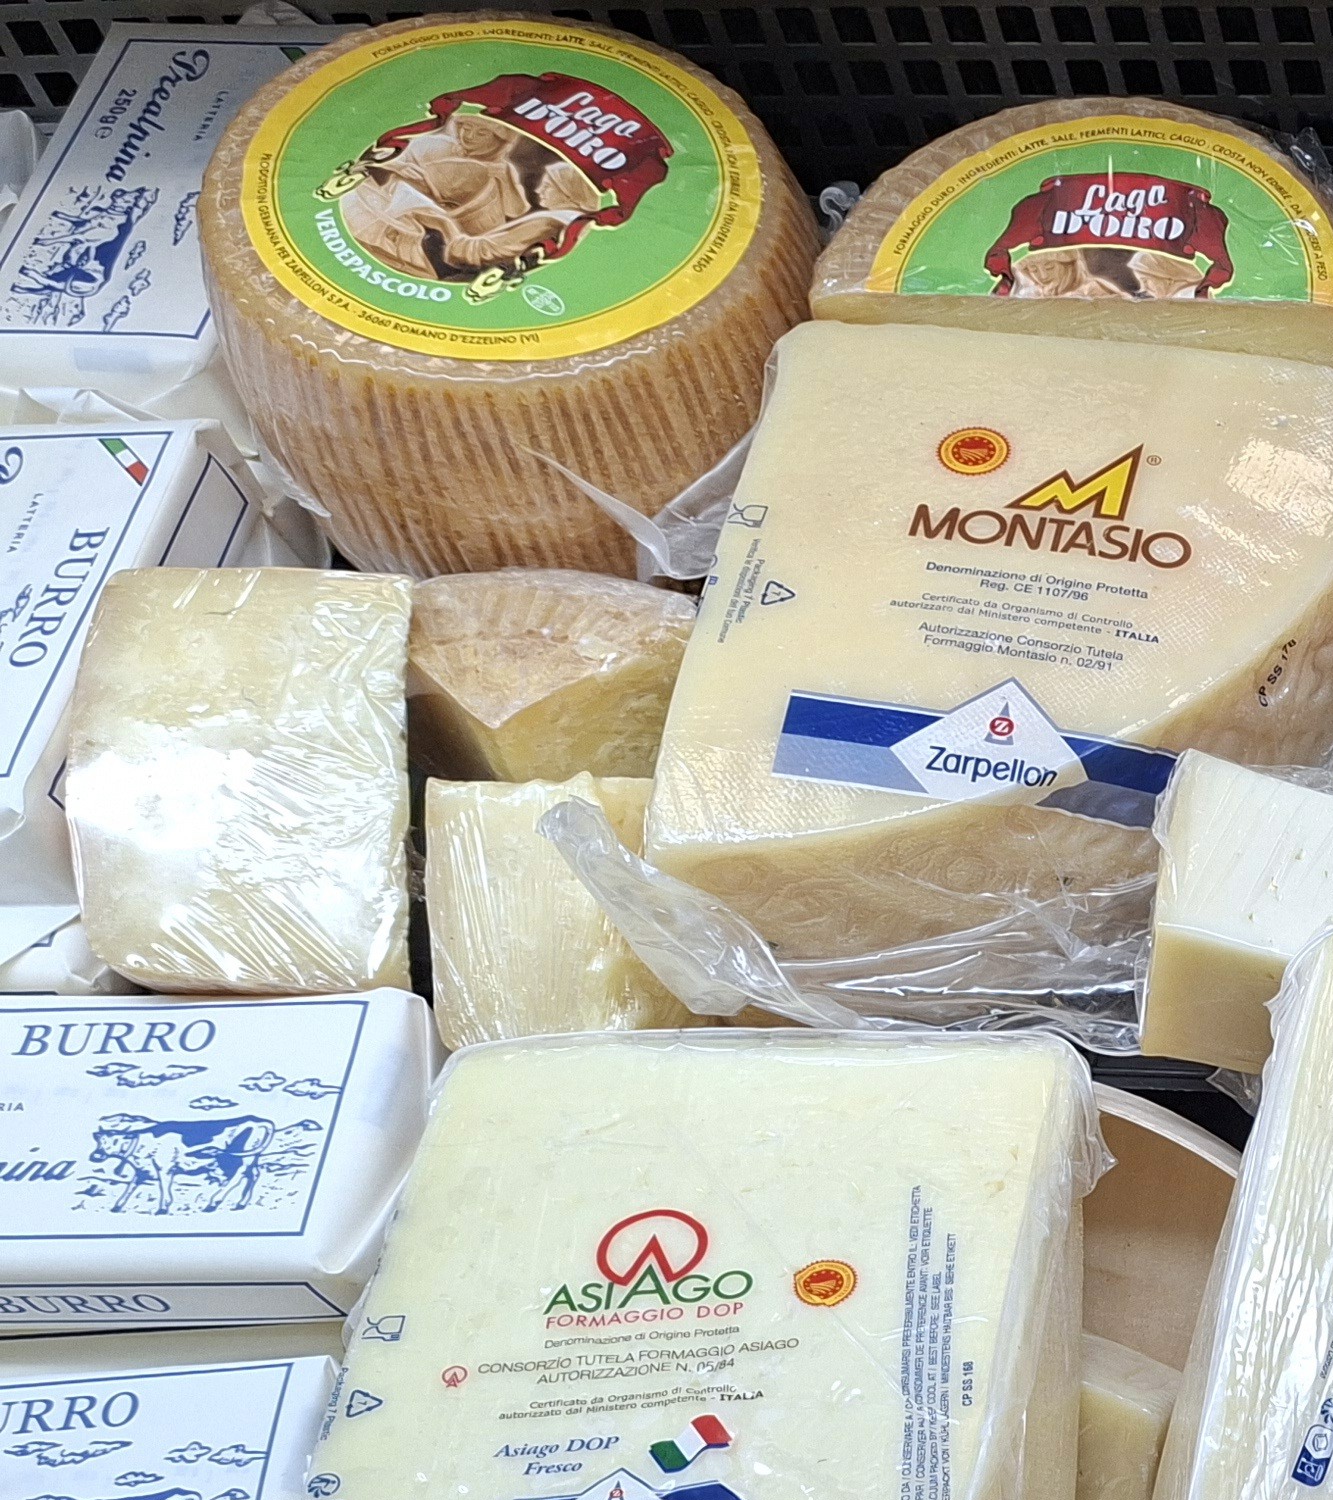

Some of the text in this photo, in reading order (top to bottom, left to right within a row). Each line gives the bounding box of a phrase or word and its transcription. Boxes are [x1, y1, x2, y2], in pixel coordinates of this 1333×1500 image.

[548, 91, 639, 139] Lago
[1079, 126, 1129, 140] FERMENTI
[1075, 184, 1168, 217] Lago
[314, 208, 452, 302] VERDEPASCOLO
[393, 322, 447, 342] ROMANO
[908, 503, 1192, 569] MONTASIO
[9, 526, 110, 668] BURRO
[925, 561, 1149, 599] Denominazione Origine Protetta
[980, 578, 1089, 601] Reg. CE 1107/96
[921, 592, 1133, 629] Certificato Organismo Controllo
[978, 608, 1160, 644] Ministero competente ITALIA
[918, 621, 1124, 661] Autorizzazione Consorzio Tutela
[923, 634, 1113, 672] Formaggio Montasio 02/91
[1267, 664, 1283, 685] SS
[925, 745, 1058, 787] Zarpellon
[11, 1019, 216, 1056] BURRO
[0, 1293, 171, 1315] BURRO
[543, 1263, 754, 1315] ASIAGO
[546, 1302, 745, 1329] FORMAGGIO DOP
[544, 1325, 740, 1349] Denominazione Origine Protetta
[477, 1338, 800, 1375] CONSORZIO TUTELA FORMAGGIO ASIAGO
[536, 1362, 671, 1384] AUTORIZZAZIONE
[675, 1362, 692, 1373] N.
[0, 1391, 139, 1435] RRO
[529, 1390, 668, 1411] Certificato Organismo
[586, 1401, 638, 1414] Ministero
[492, 1436, 620, 1459] Asiago DOP
[523, 1461, 583, 1476] Fresco
